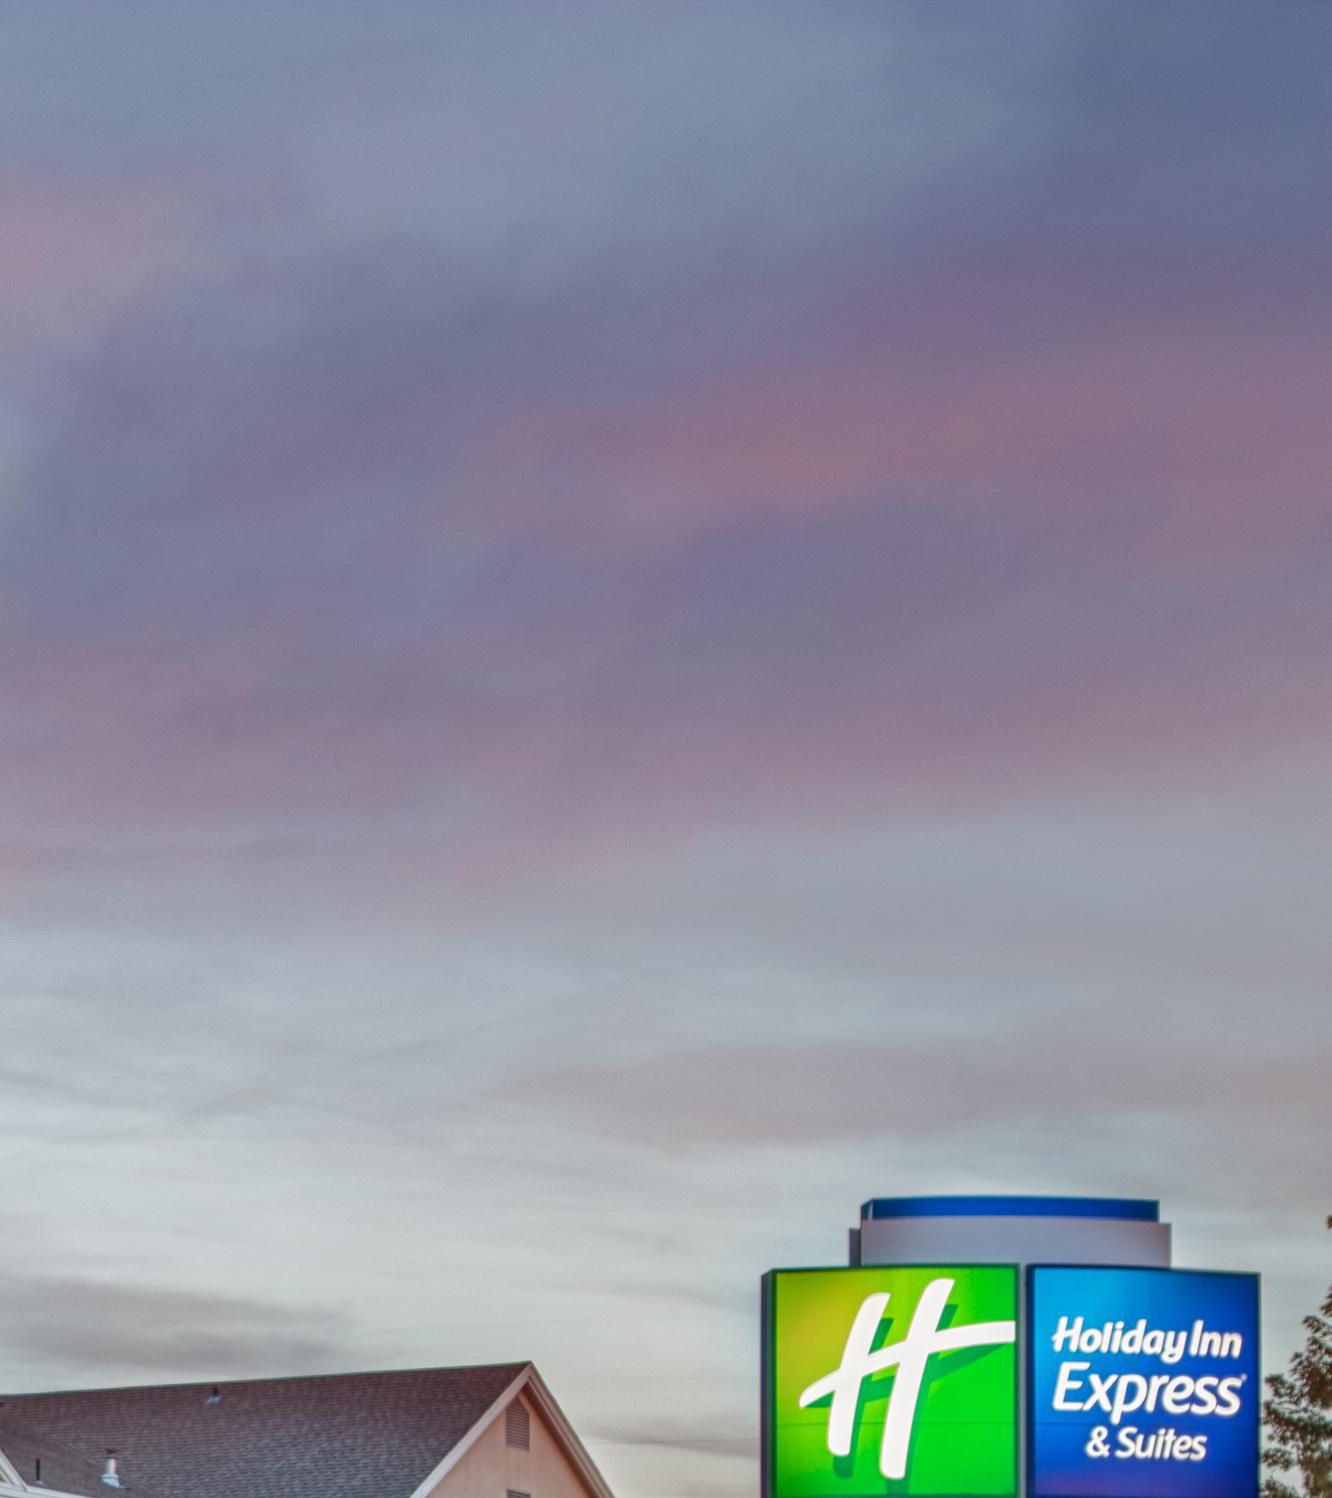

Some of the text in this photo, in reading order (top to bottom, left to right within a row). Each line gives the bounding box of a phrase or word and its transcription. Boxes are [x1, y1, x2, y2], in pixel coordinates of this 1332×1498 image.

[1051, 1316, 1243, 1364] Holiday Inn
[1052, 1361, 1243, 1425] Express
[1085, 1425, 1208, 1461] & Suites
